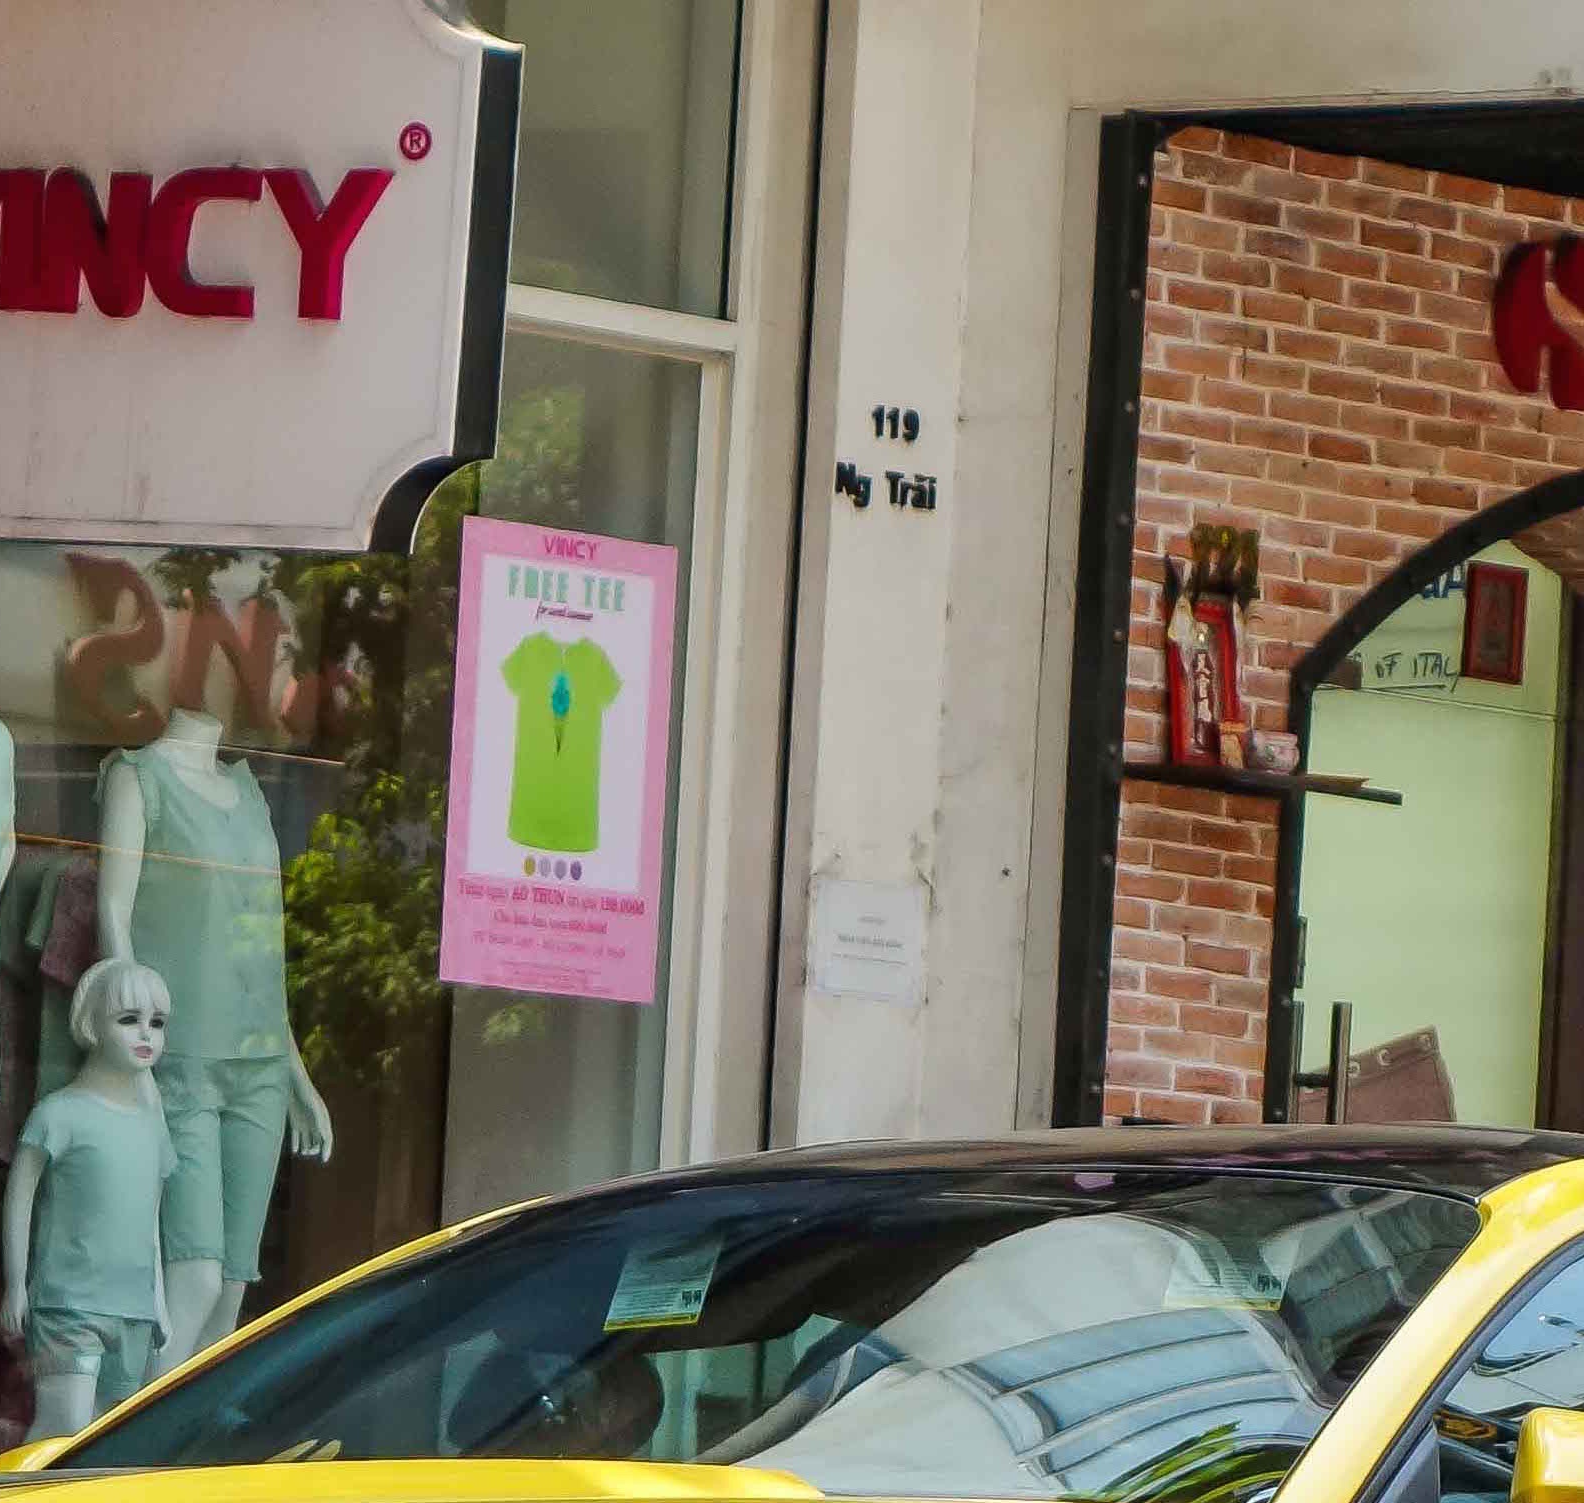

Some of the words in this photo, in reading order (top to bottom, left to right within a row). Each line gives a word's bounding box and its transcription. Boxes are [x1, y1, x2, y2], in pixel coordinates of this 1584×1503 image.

[871, 404, 921, 441] 119
[835, 461, 873, 508] Ng
[544, 534, 600, 561] VINCY
[508, 564, 568, 604] FREE
[583, 573, 625, 612] TEE
